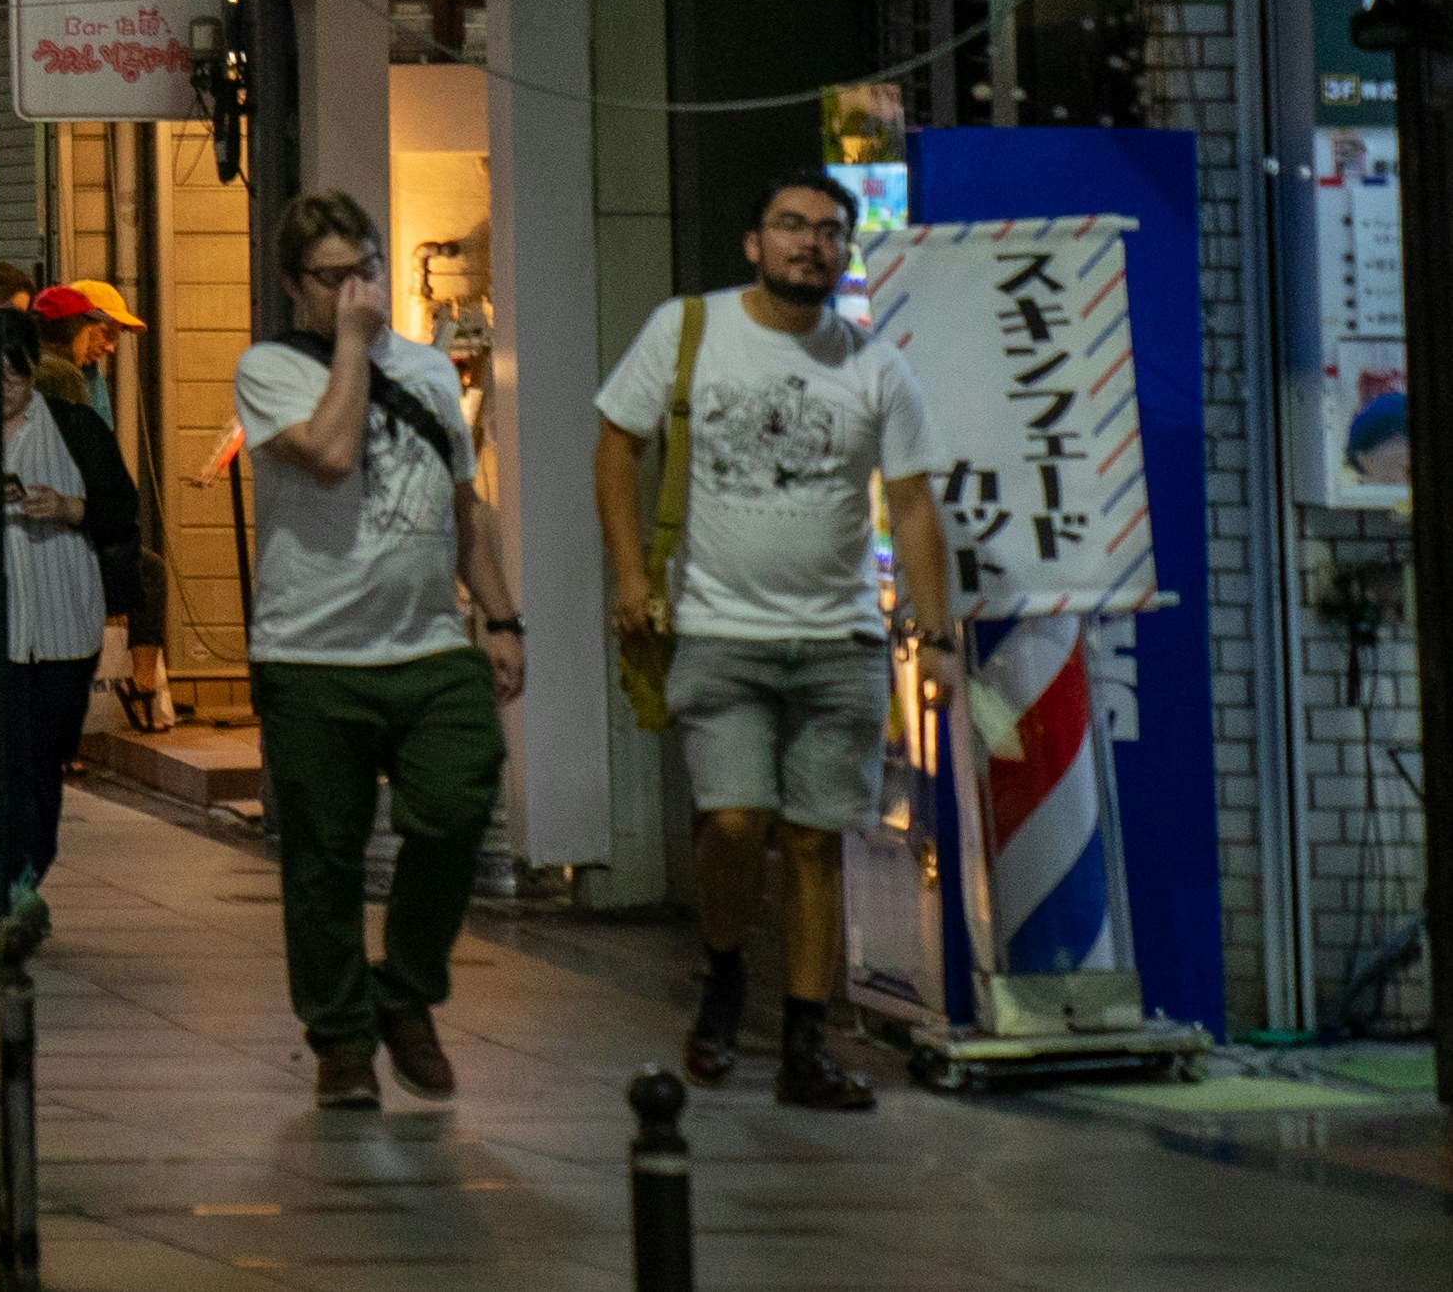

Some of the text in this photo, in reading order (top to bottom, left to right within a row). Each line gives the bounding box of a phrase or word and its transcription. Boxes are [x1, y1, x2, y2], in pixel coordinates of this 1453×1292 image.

[64, 19, 108, 37] Bar
[992, 250, 1089, 563] スキンフェード
[939, 459, 1011, 597] カット
